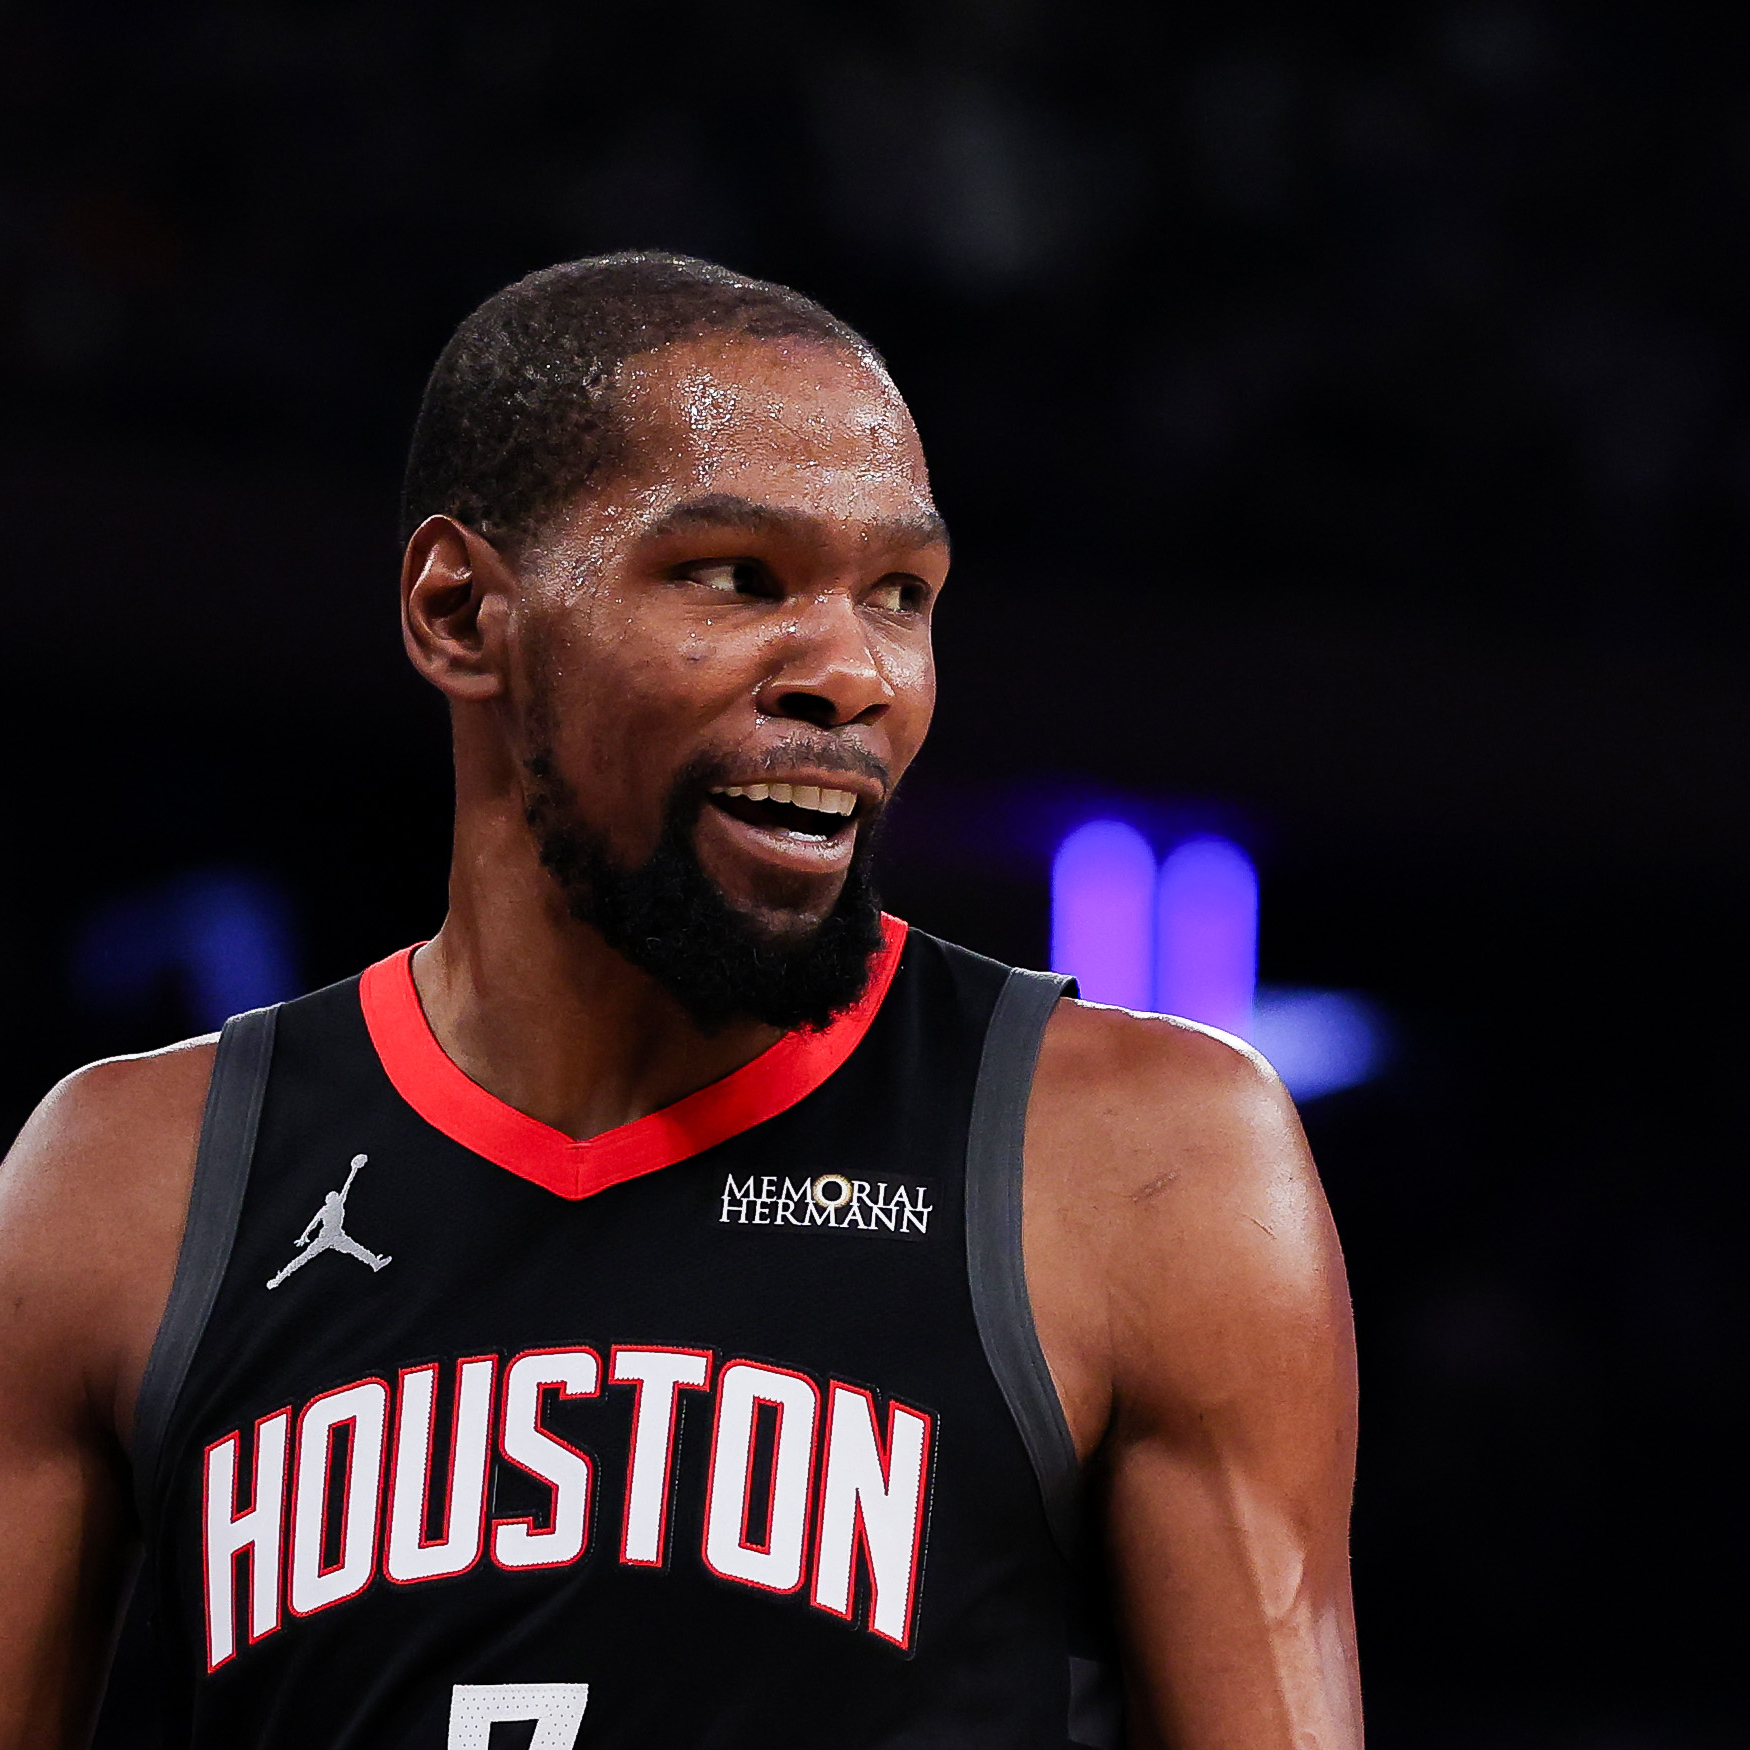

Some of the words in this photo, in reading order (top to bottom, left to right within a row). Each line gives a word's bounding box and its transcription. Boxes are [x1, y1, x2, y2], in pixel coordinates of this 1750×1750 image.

[721, 1173, 933, 1212] MEMORIAL
[718, 1195, 933, 1234] HERMANN
[202, 1344, 941, 1675] HOUSTON
